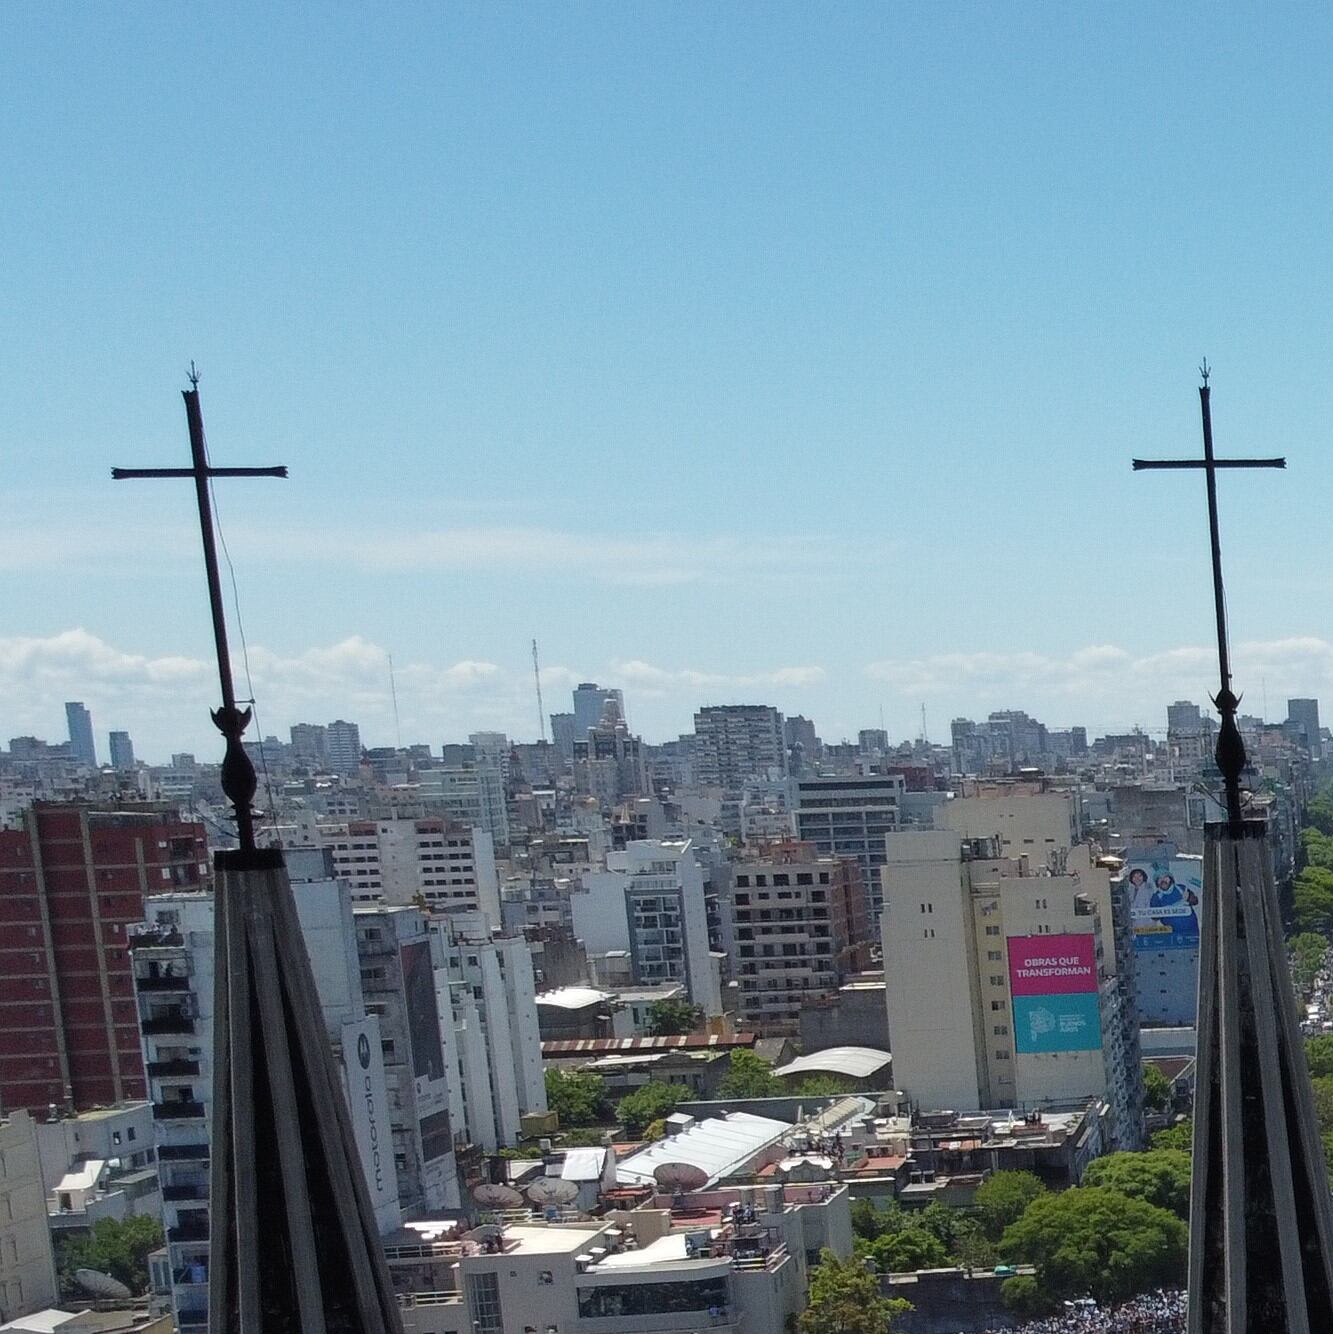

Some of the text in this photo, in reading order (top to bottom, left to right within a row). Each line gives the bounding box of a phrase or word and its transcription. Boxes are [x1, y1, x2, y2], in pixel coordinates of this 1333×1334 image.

[1024, 957, 1080, 967] OBRAS QUE
[1016, 967, 1091, 978] TRANSFORMAN
[364, 1075, 383, 1193] motorola
